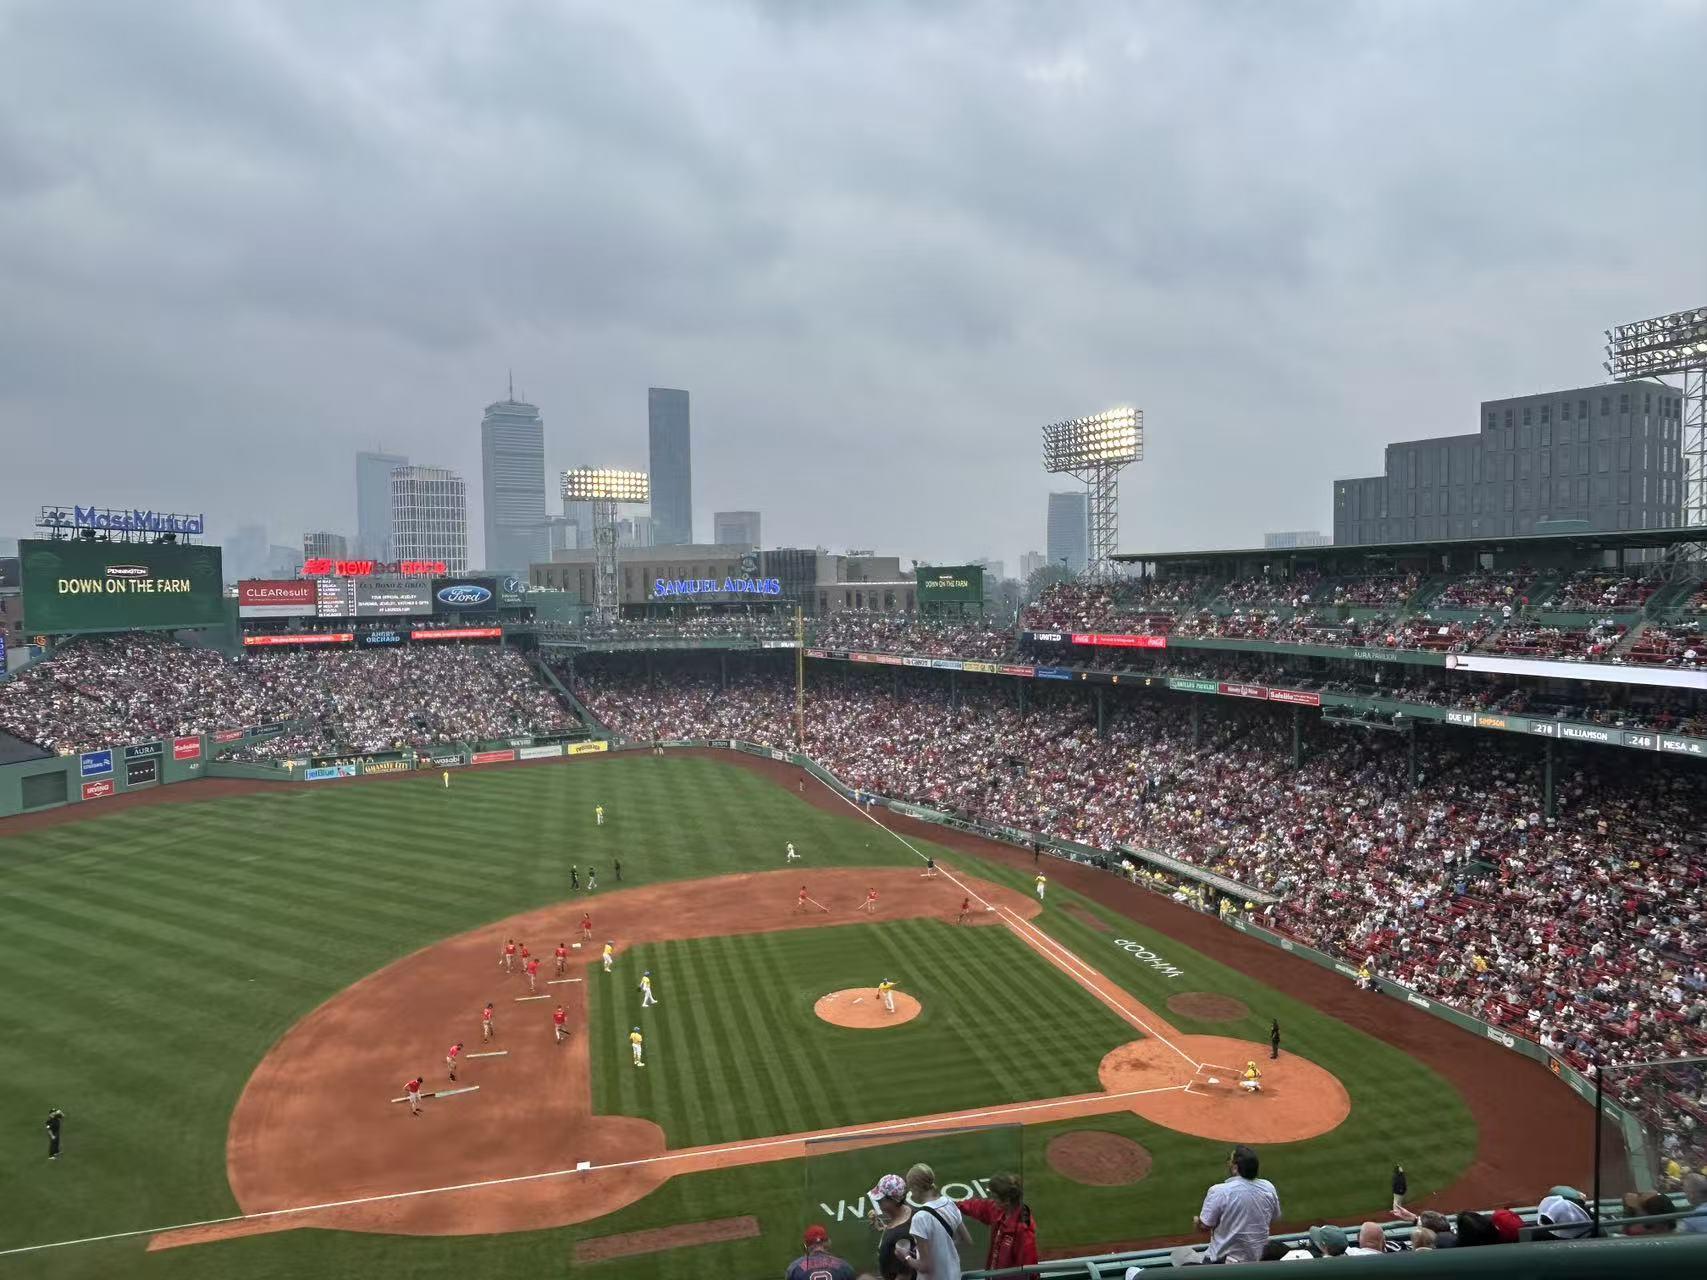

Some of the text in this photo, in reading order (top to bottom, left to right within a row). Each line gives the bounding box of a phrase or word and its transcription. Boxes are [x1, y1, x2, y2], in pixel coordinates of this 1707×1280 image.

[74, 505, 203, 534] MassMutual
[335, 560, 372, 576] new
[58, 579, 190, 594] DOWN ON THE FARM
[246, 588, 309, 597] CLEAResult
[654, 577, 781, 596] SAMUEL ADAMS
[448, 588, 481, 602] Ford
[1448, 713, 1462, 721] DUE
[1462, 714, 1473, 722] UP
[1478, 717, 1505, 728] SIMPSON
[1563, 727, 1608, 741] WILLIAMSON
[1663, 741, 1688, 751] MESA
[434, 755, 460, 764] wasabi
[308, 769, 334, 779] jetBlue
[87, 784, 110, 794] IRVING
[1114, 939, 1184, 978] WHOOP
